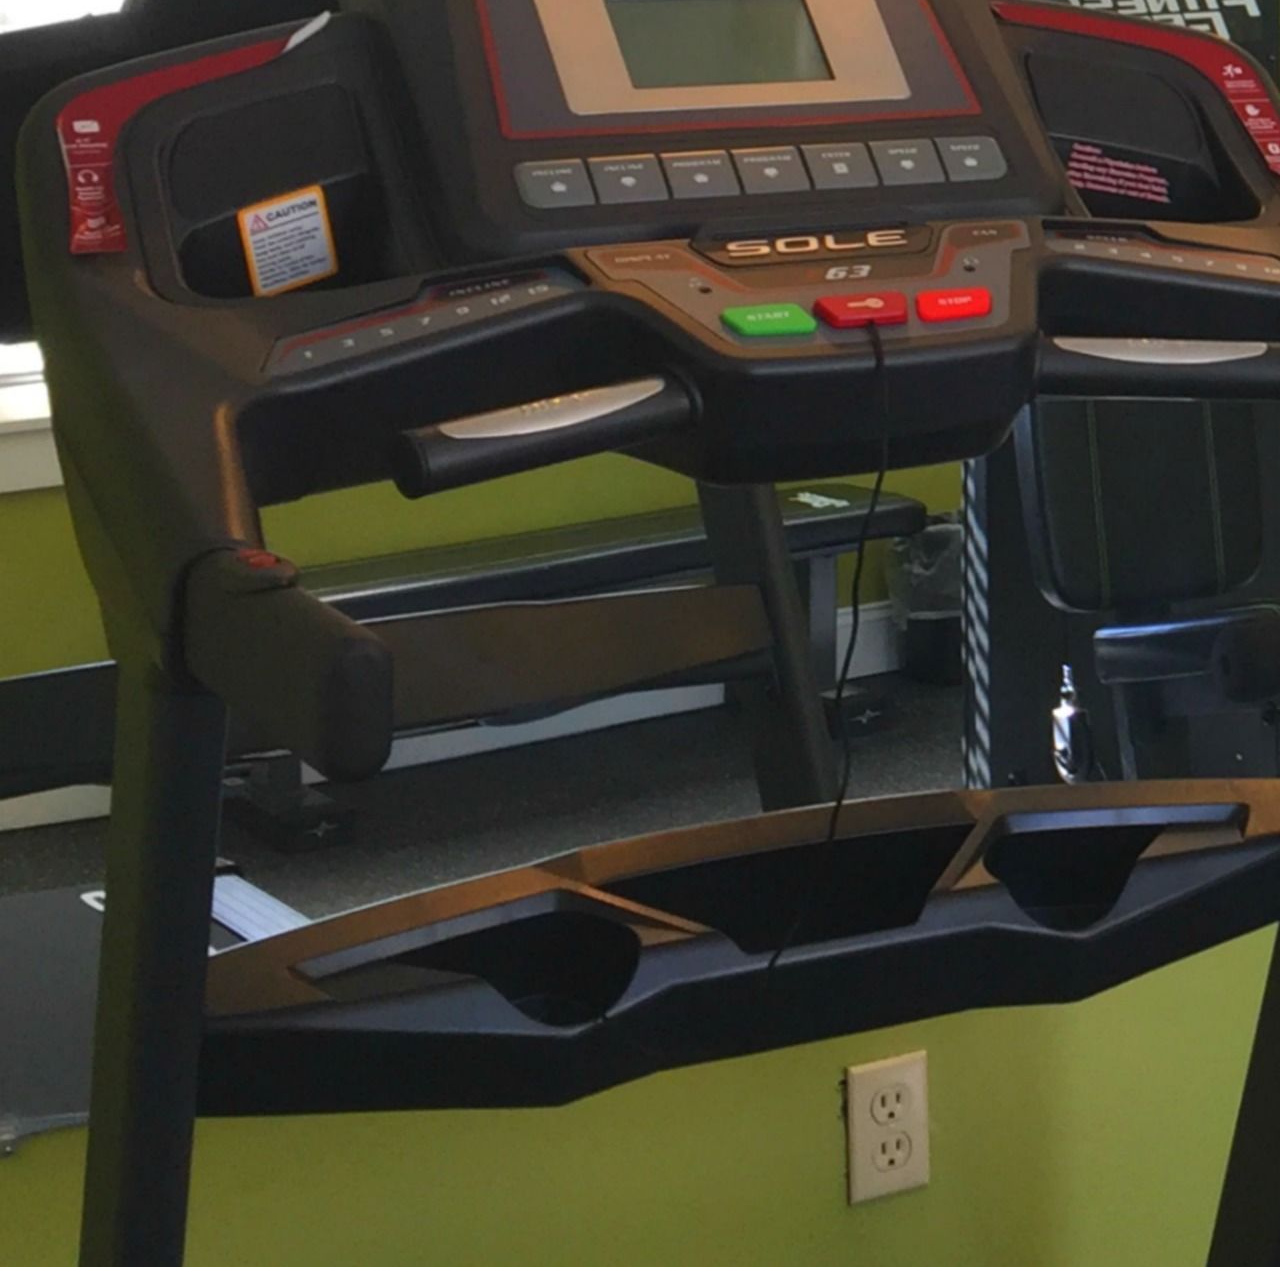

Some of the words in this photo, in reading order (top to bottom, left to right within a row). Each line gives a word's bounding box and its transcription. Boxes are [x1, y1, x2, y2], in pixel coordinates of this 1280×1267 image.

[265, 199, 318, 222] CAUTION
[725, 229, 908, 258] SOLE
[937, 296, 973, 306] STOP
[746, 311, 790, 321] START
